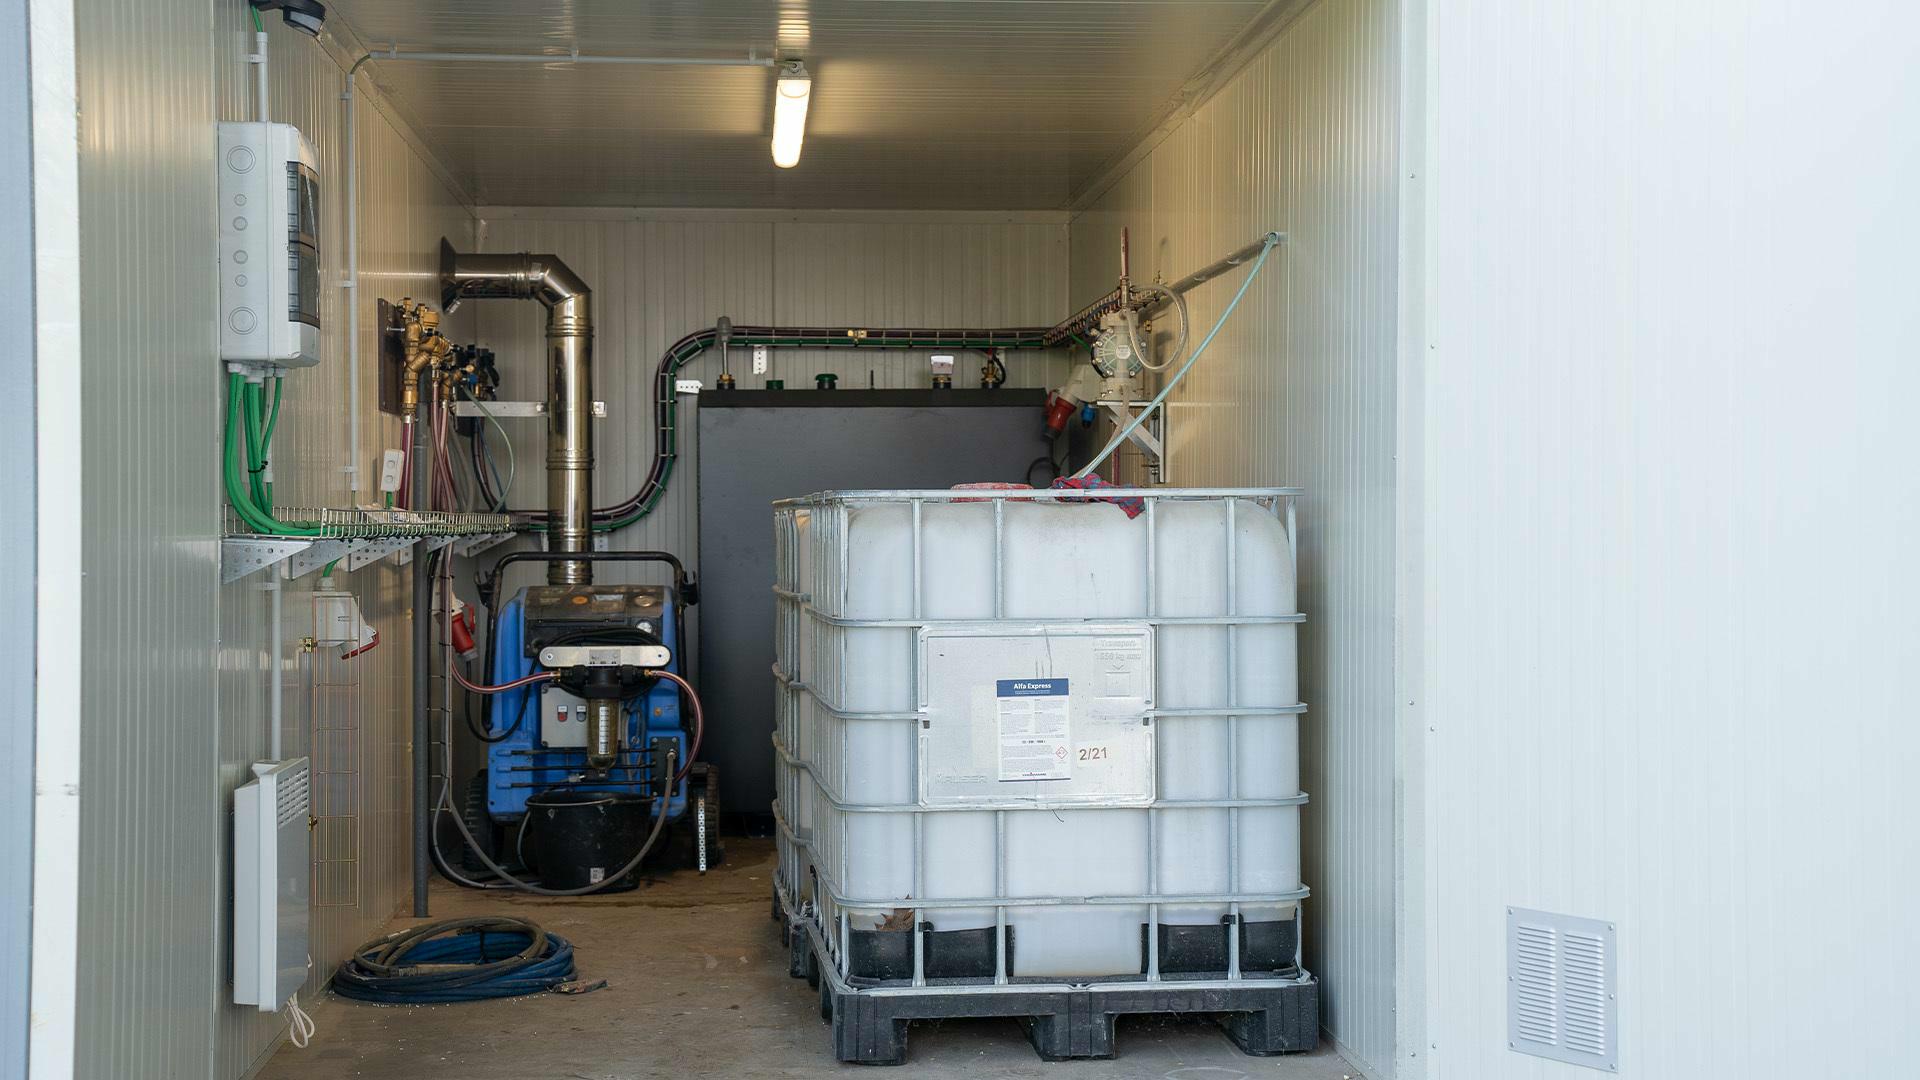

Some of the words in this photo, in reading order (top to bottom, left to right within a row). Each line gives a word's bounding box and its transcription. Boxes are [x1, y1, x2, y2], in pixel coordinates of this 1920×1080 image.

[1013, 682, 1026, 690] Alfa
[1027, 681, 1052, 690] Express
[1079, 746, 1108, 761] 2/21
